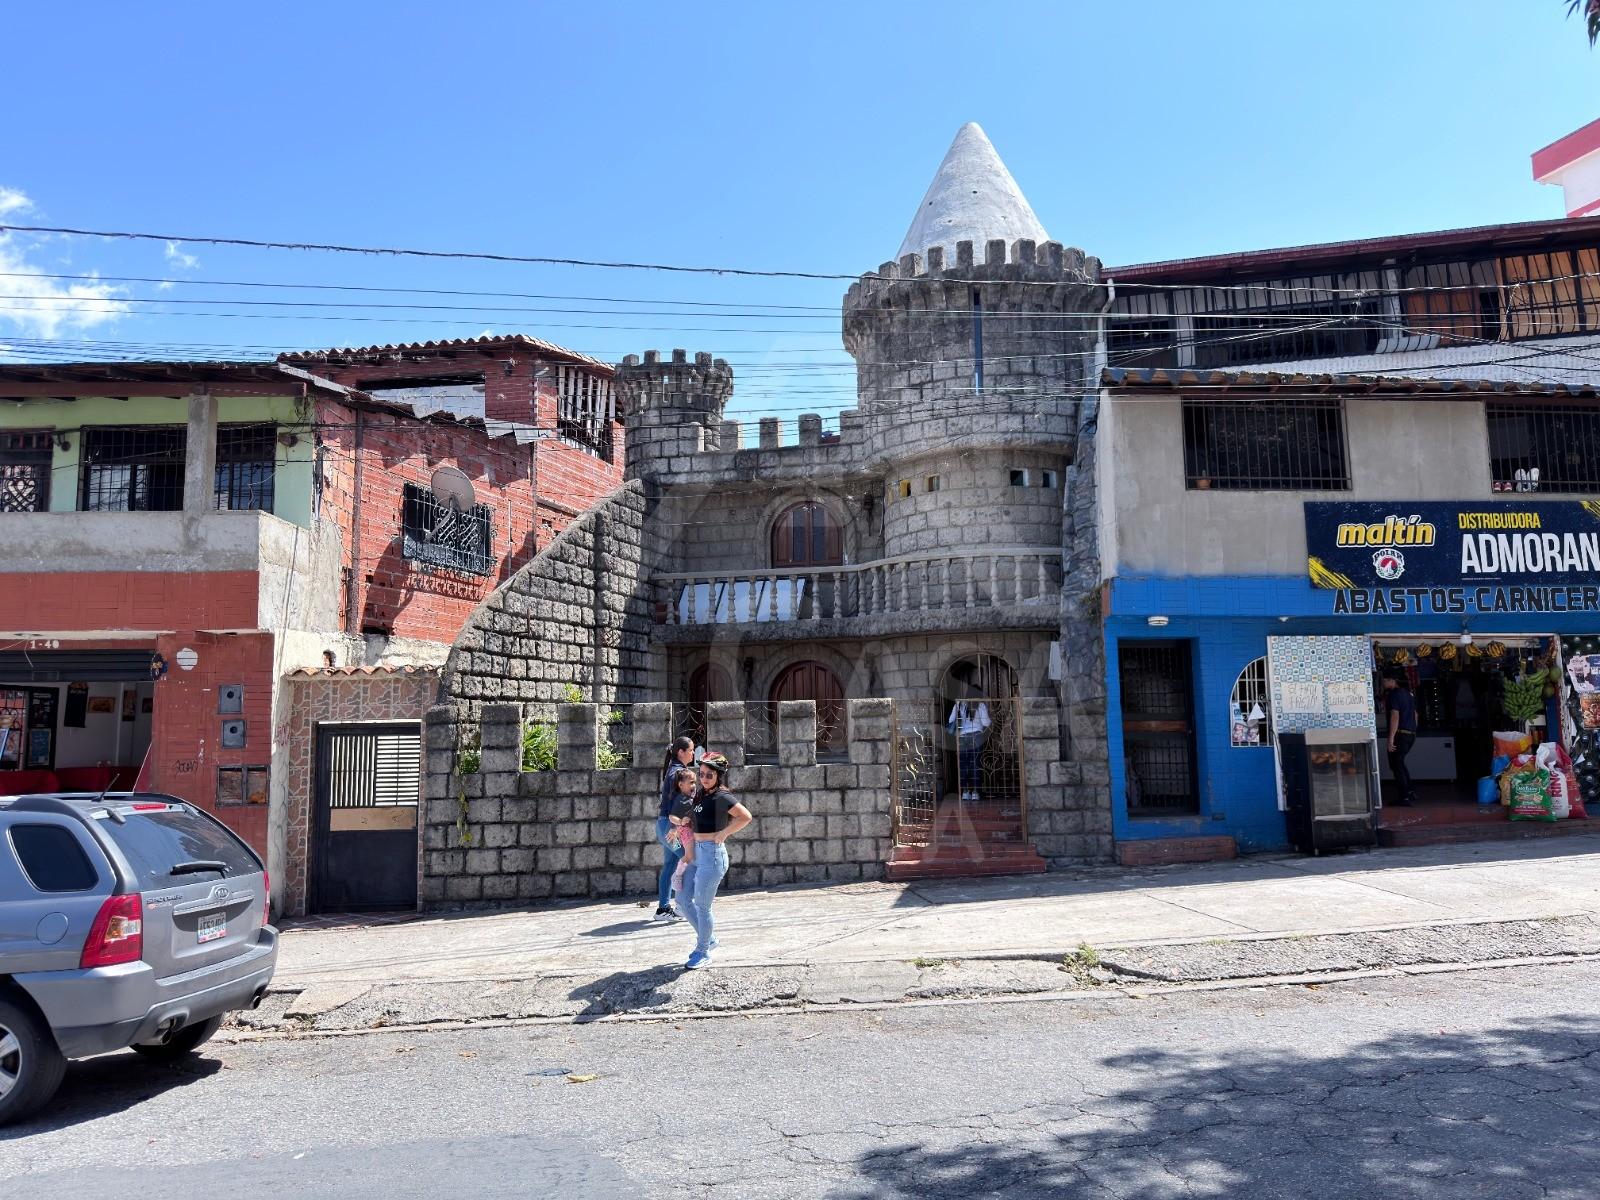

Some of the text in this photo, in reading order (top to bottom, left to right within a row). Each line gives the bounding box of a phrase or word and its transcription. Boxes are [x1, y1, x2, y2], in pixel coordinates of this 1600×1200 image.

[1337, 515, 1435, 547] maltín
[1458, 512, 1541, 528] DISTRIBUIDORA
[1461, 532, 1600, 573] ADMORAN
